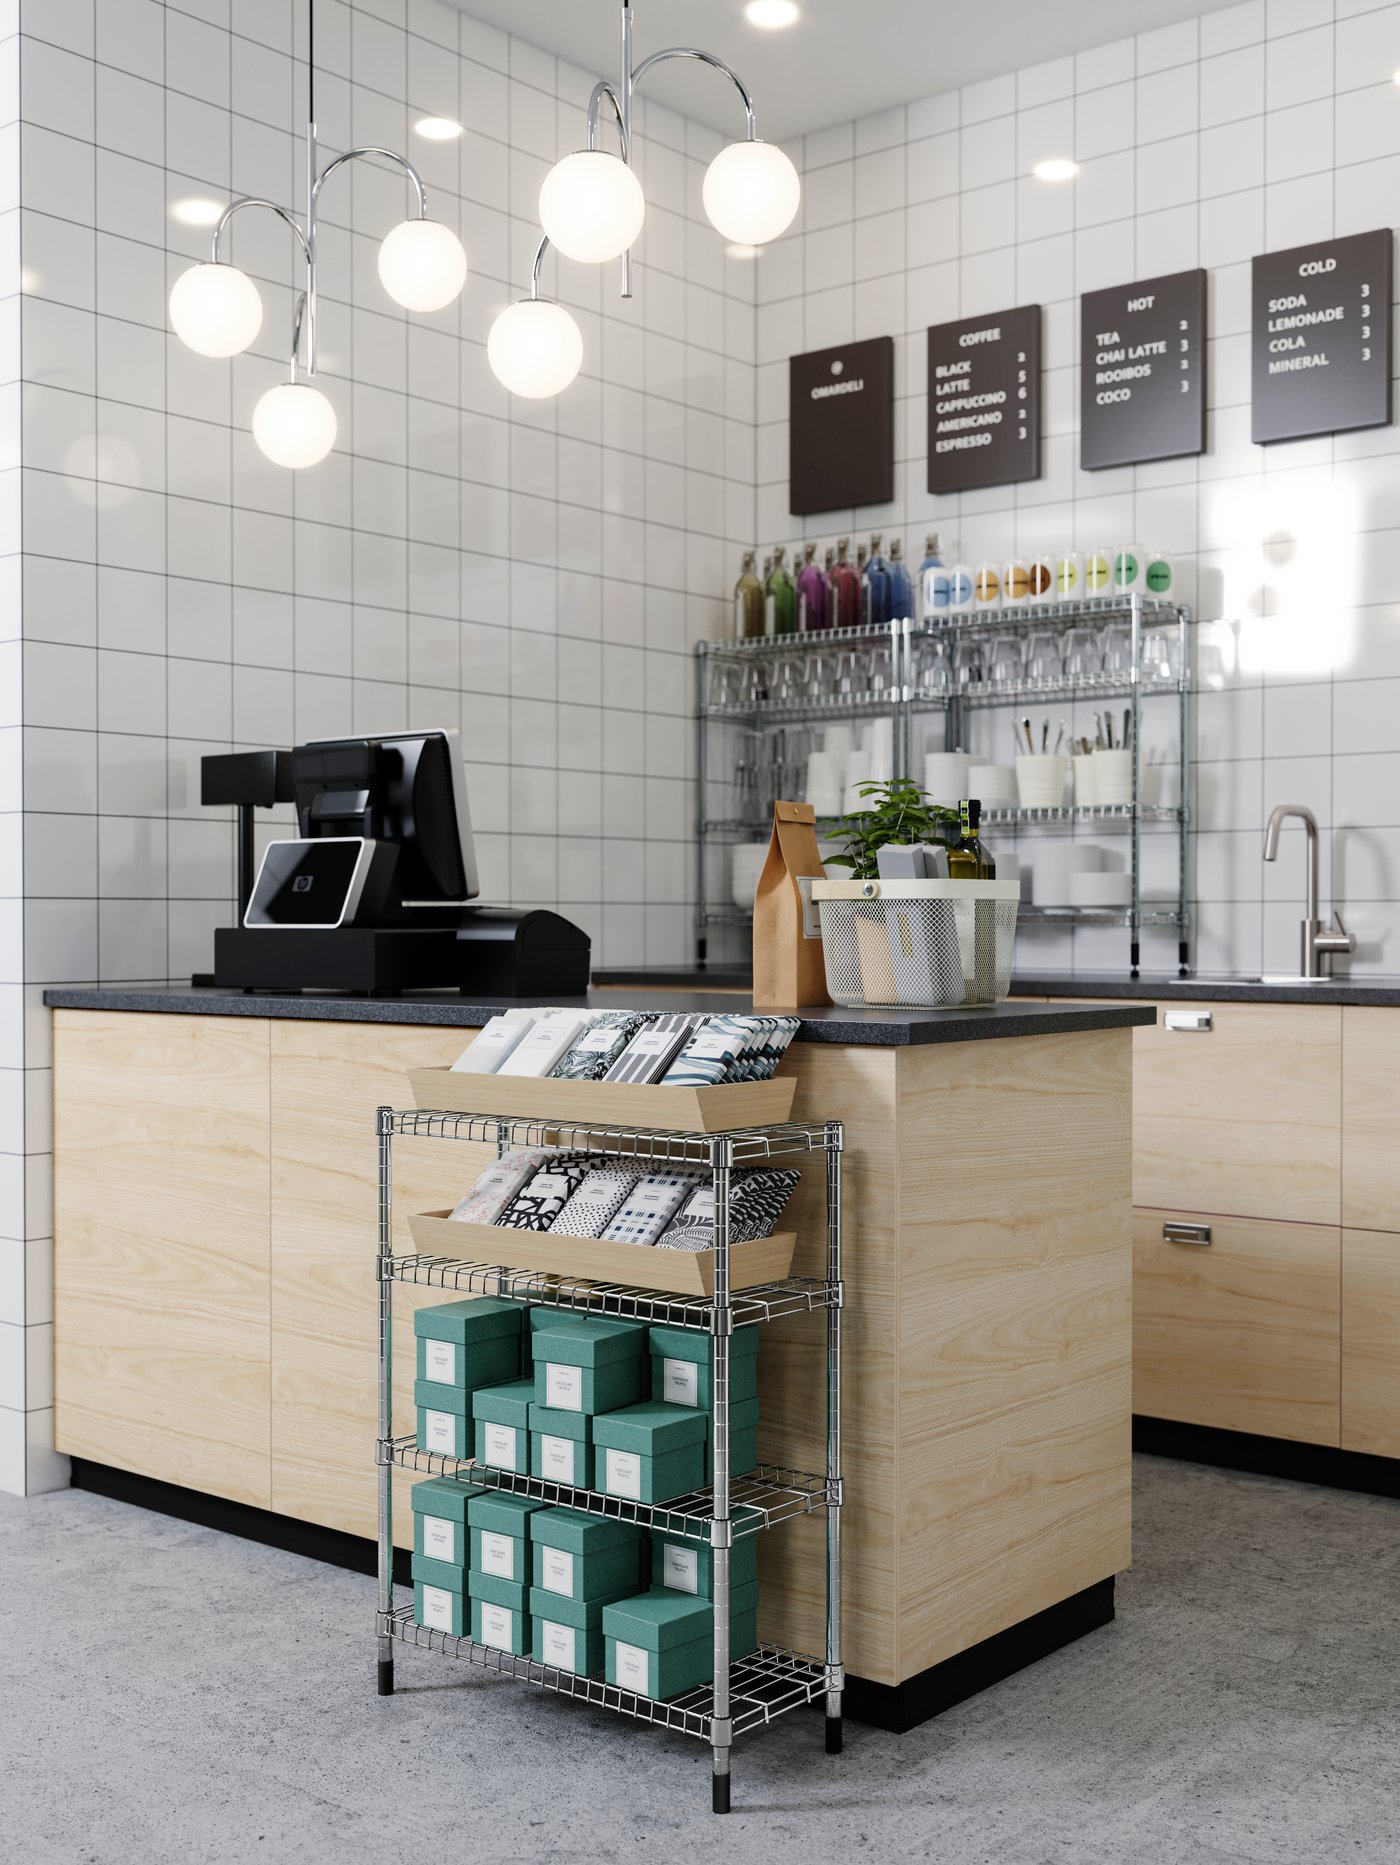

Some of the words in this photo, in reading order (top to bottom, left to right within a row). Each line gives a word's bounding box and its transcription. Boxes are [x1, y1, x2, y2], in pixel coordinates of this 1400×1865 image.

[1299, 258, 1337, 277] COLD
[1127, 295, 1155, 312] HOT
[1269, 294, 1307, 313] SODA
[1361, 284, 1370, 297] 3
[1268, 306, 1344, 332] LEMONADE
[1362, 304, 1370, 318] 3
[959, 328, 1001, 347] COFFEE
[1096, 331, 1120, 346] TEA
[1269, 336, 1306, 353] COLA
[1362, 326, 1370, 339] 3
[1096, 349, 1125, 365] CHAI
[1128, 341, 1167, 359] LATTE
[1180, 339, 1189, 352] 3
[1269, 353, 1329, 374] MINERAL
[1362, 348, 1371, 361] 3
[936, 360, 971, 378] BLACK
[1096, 364, 1151, 385] ROOIBOS
[936, 378, 970, 396] LATTE
[1096, 388, 1131, 405] COCO
[1181, 380, 1189, 393] 3
[936, 391, 1006, 414] CAPPUCCINO
[937, 411, 1002, 433] AMERICANO
[936, 433, 992, 453] ESPRESSO
[1019, 427, 1027, 439] 3
